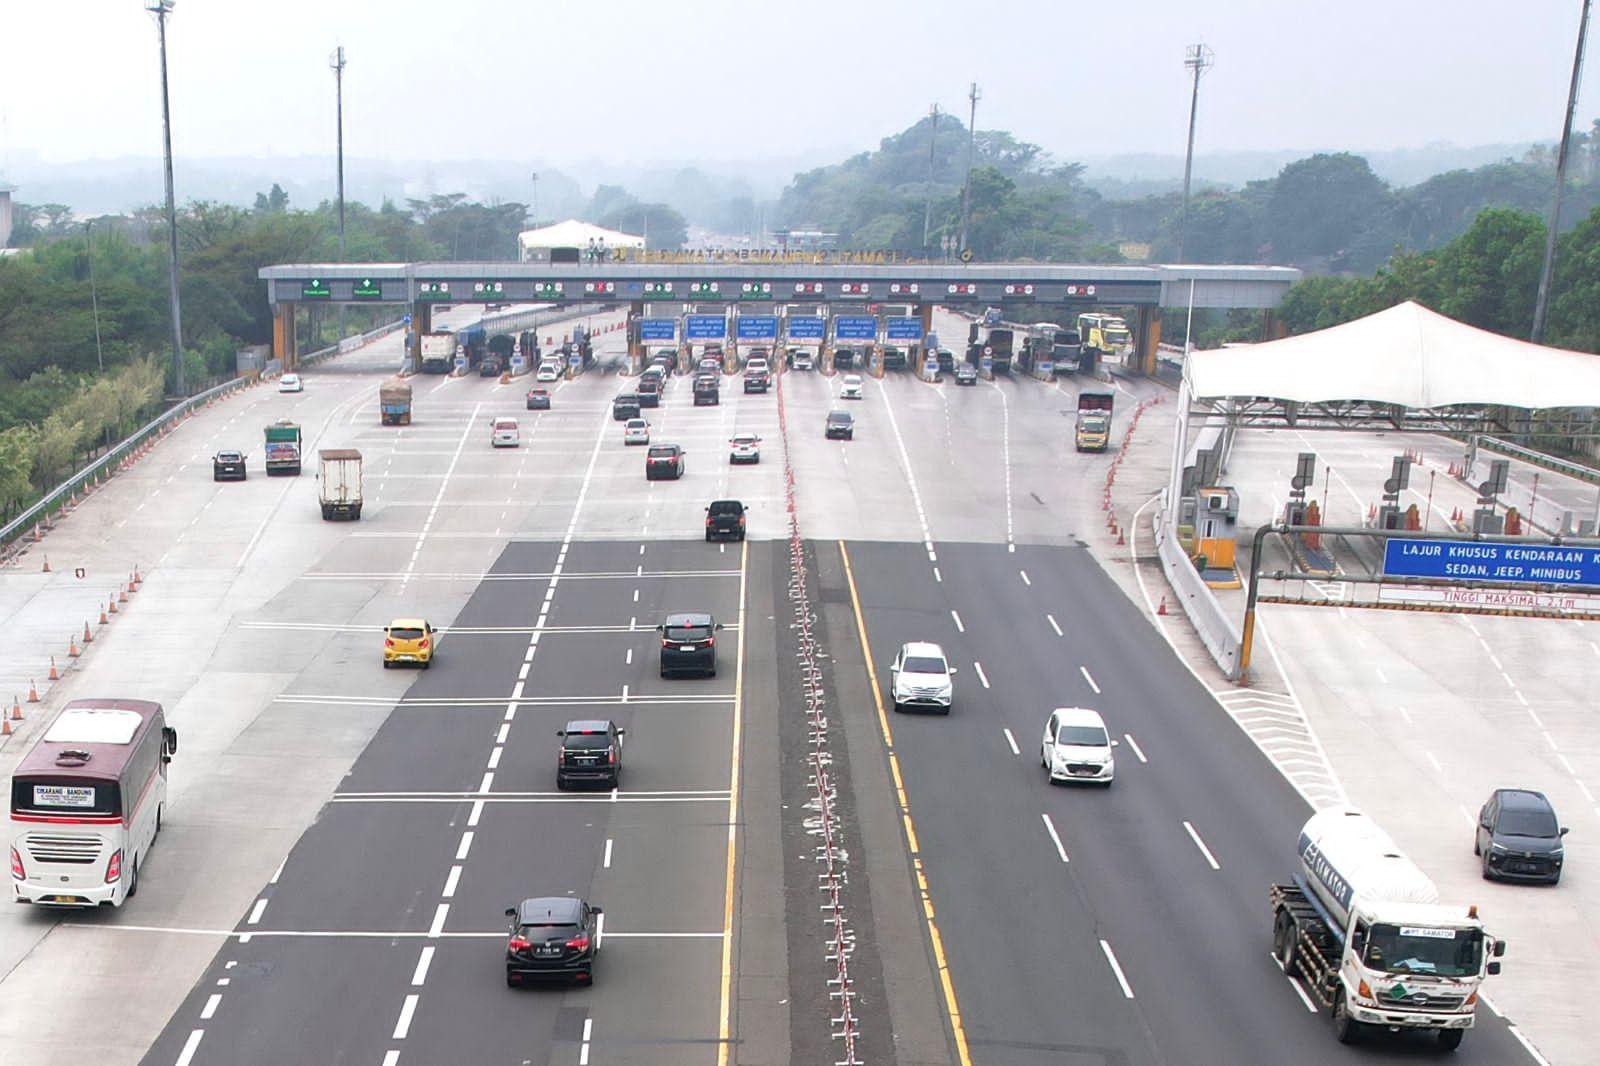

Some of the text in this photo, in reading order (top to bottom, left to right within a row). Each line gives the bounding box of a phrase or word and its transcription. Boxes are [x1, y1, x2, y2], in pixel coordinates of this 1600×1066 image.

[1403, 544, 1442, 556] LAJUR
[1448, 547, 1497, 559] KHUSUS
[1505, 550, 1583, 563] KENDARAAN
[1445, 563, 1490, 577] SEDAN,
[1530, 567, 1582, 580] MINIBUS
[1443, 591, 1479, 602] TINGGI
[1485, 593, 1541, 607] MAKSIMAL
[1316, 857, 1346, 902] SAMATOR
